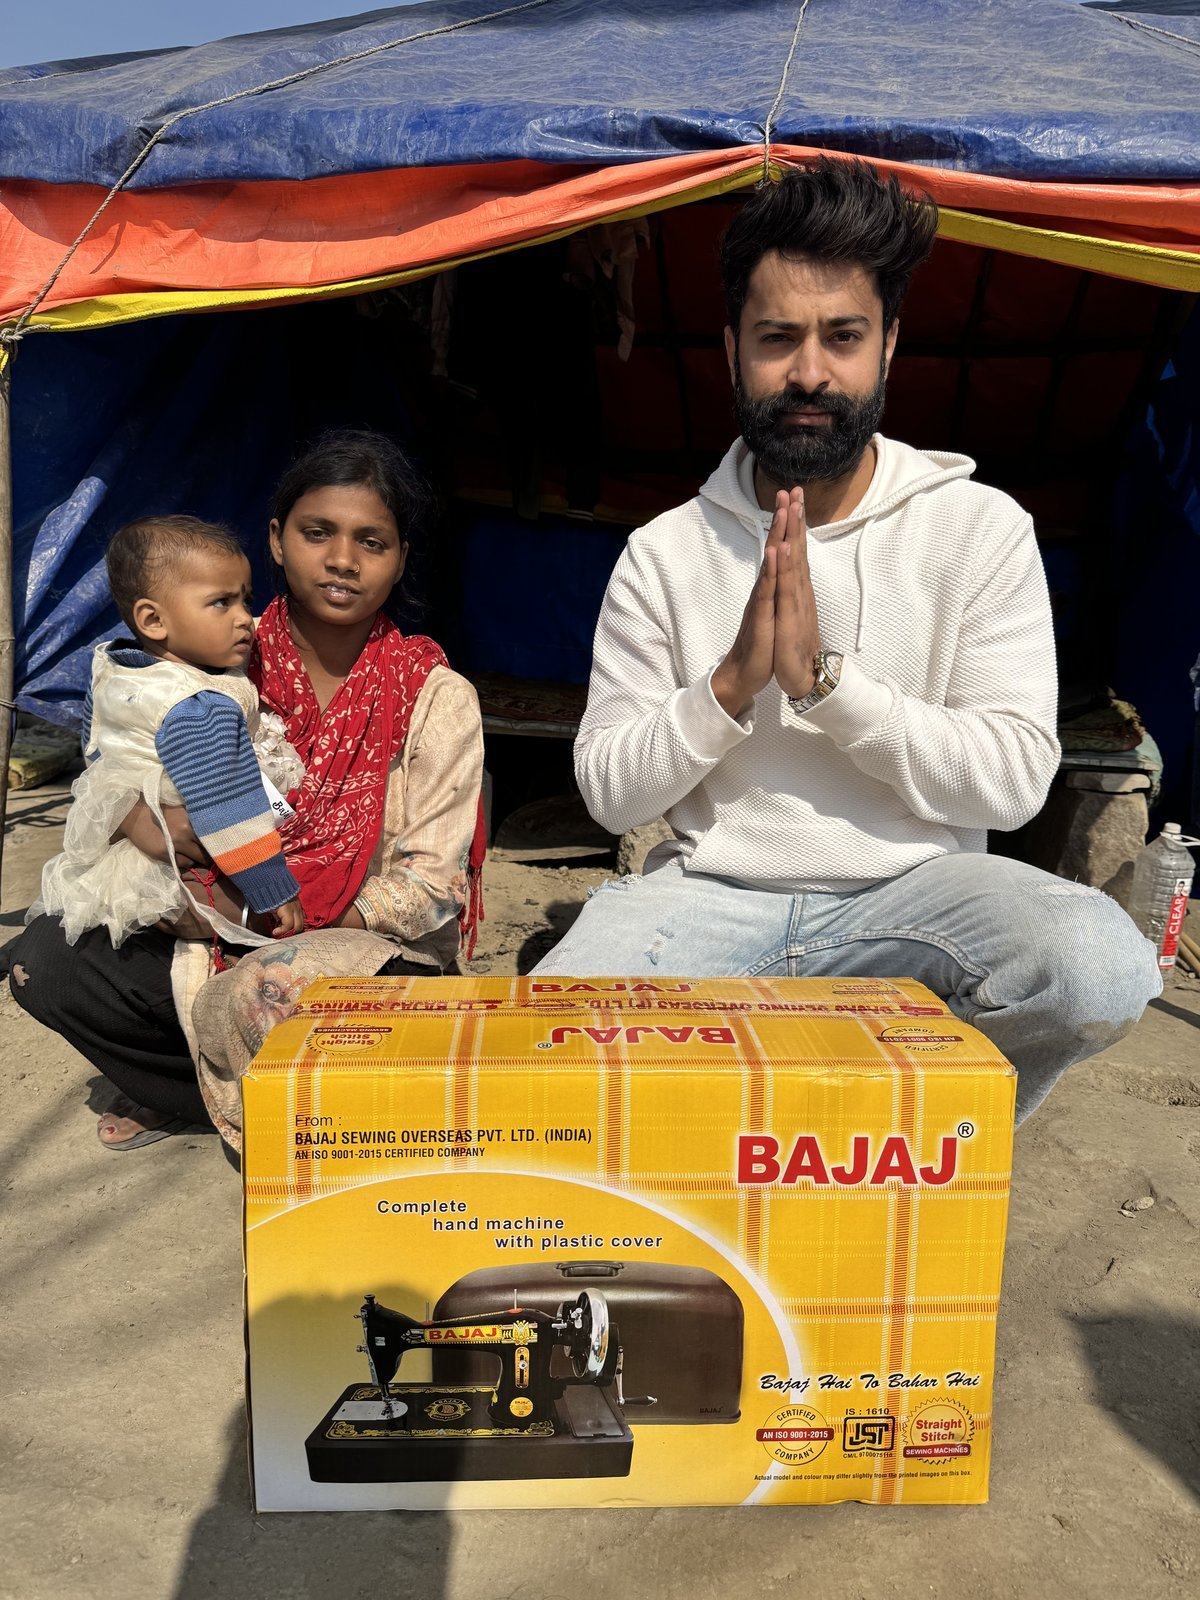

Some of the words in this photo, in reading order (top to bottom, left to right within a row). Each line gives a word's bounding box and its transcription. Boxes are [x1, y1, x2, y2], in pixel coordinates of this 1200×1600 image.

[1169, 897, 1185, 934] CLEAR
[295, 1114, 333, 1127] From
[295, 1131, 337, 1145] BAJAJ
[341, 1130, 396, 1144] SEWING
[401, 1129, 473, 1143] OVERSEAS
[477, 1129, 506, 1142] PVT.
[511, 1129, 540, 1142] LTD.
[544, 1128, 592, 1144] (INDIA)
[294, 1150, 309, 1159] AN
[311, 1150, 329, 1159] ISO
[331, 1149, 382, 1159] 9001-2015
[384, 1148, 435, 1158] CERTIFIED
[437, 1147, 486, 1157] COMPANY
[377, 1199, 467, 1216] Complete
[433, 1217, 479, 1231] hand
[486, 1216, 565, 1230] machine
[495, 1235, 534, 1248] with
[541, 1234, 604, 1250] plastic
[611, 1237, 663, 1248] cover
[429, 1327, 497, 1340] BAJAJ
[760, 1374, 810, 1393] Bajaj
[818, 1374, 852, 1390] Hai
[859, 1374, 880, 1389] To
[888, 1372, 938, 1388] Bahar
[945, 1371, 980, 1387] Hai
[776, 1408, 816, 1421] CERTIFIED
[915, 1419, 962, 1431] Straight
[762, 1431, 774, 1439] AN
[775, 1431, 789, 1439] ISO
[790, 1430, 829, 1439] 9001-2015
[921, 1431, 955, 1442] Stitch
[774, 1447, 815, 1461] COMPANY
[933, 1446, 969, 1454] MACHINES
[899, 1471, 918, 1479] printed
